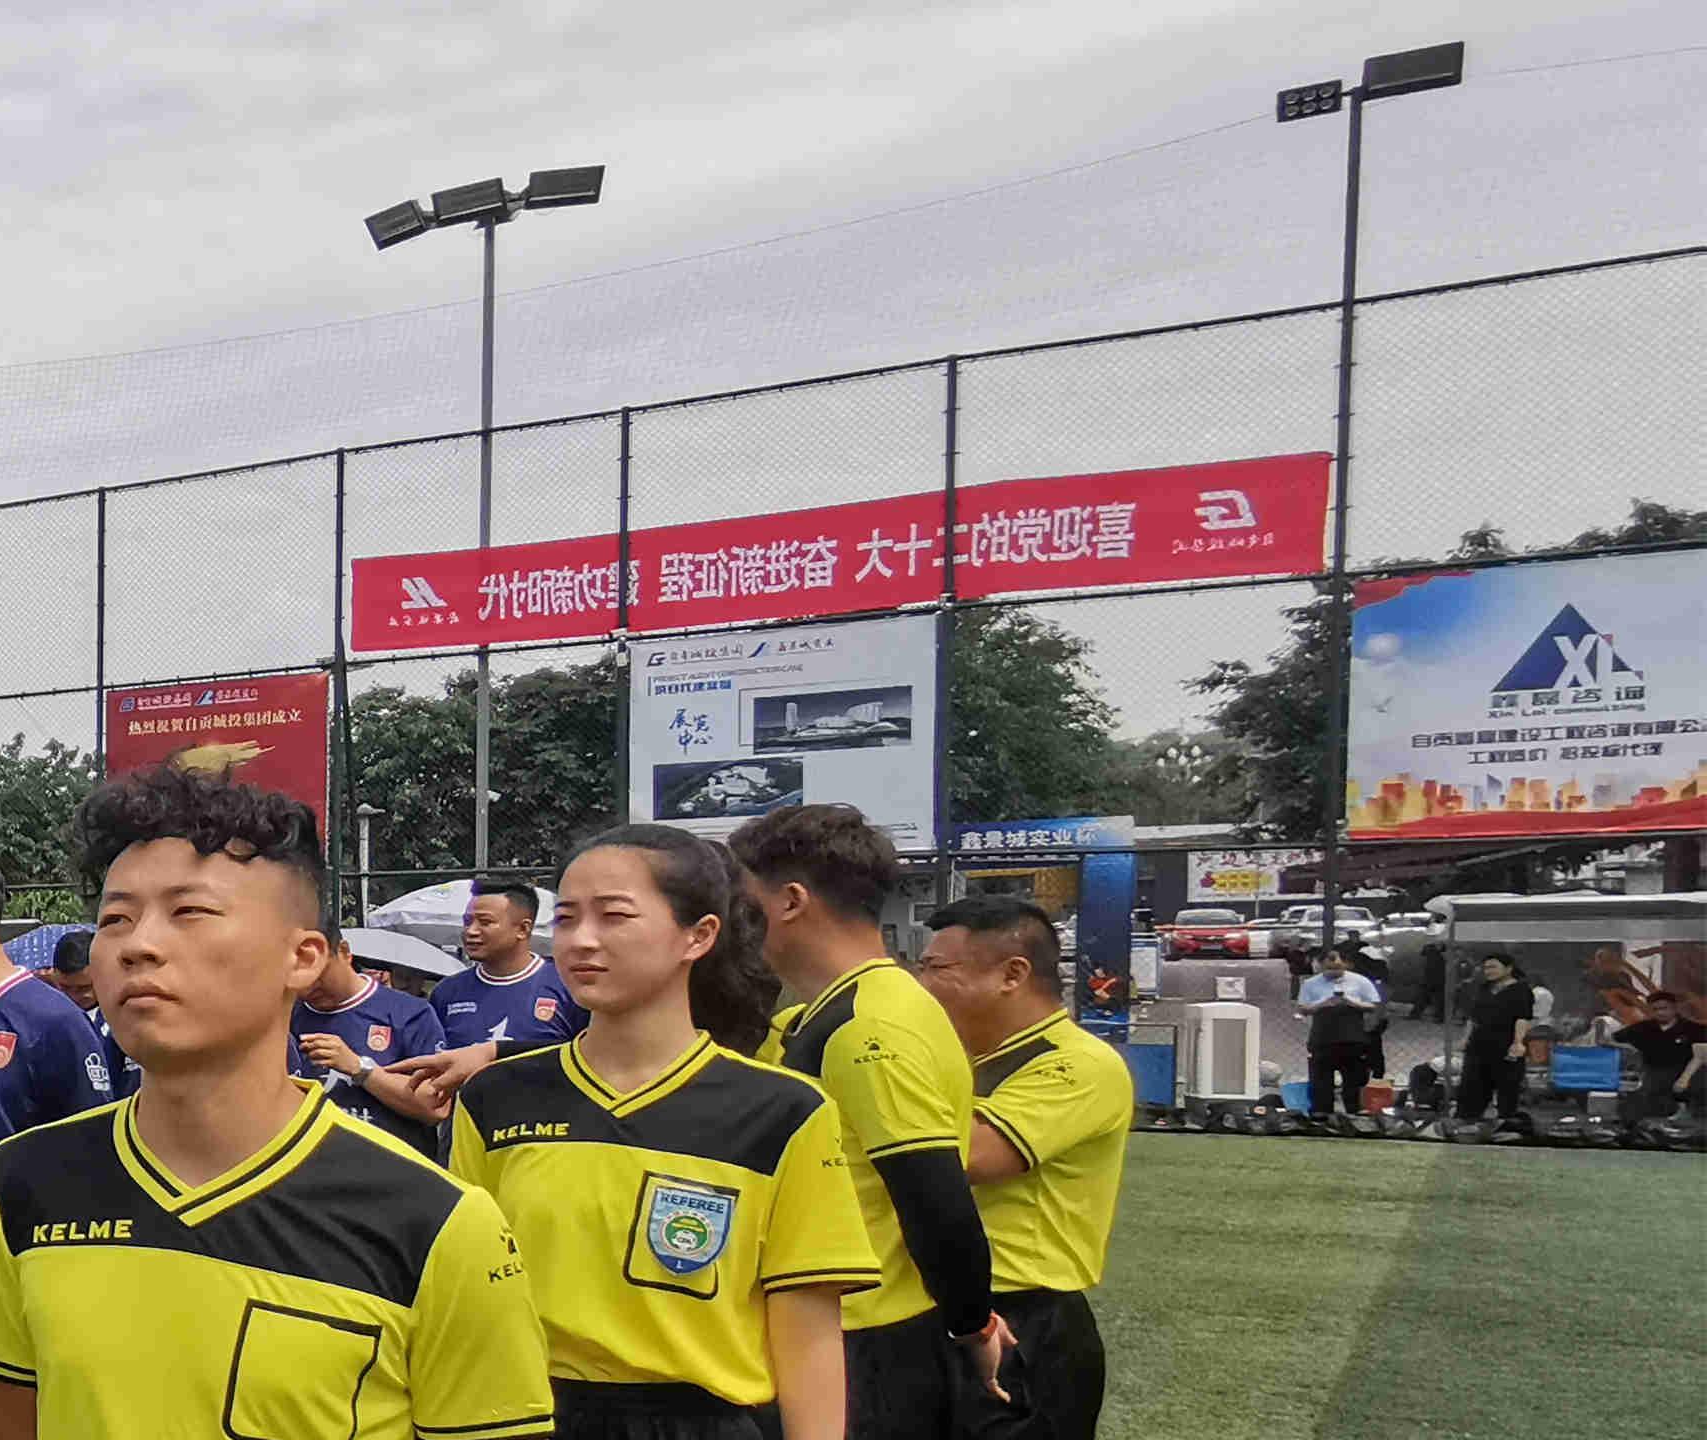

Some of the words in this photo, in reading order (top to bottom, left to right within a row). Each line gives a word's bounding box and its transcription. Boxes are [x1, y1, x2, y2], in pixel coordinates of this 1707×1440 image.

[493, 1122, 570, 1141] KELME
[660, 1191, 724, 1214] REFEREE
[32, 1218, 133, 1243] KELME
[488, 1261, 524, 1283] KEL
